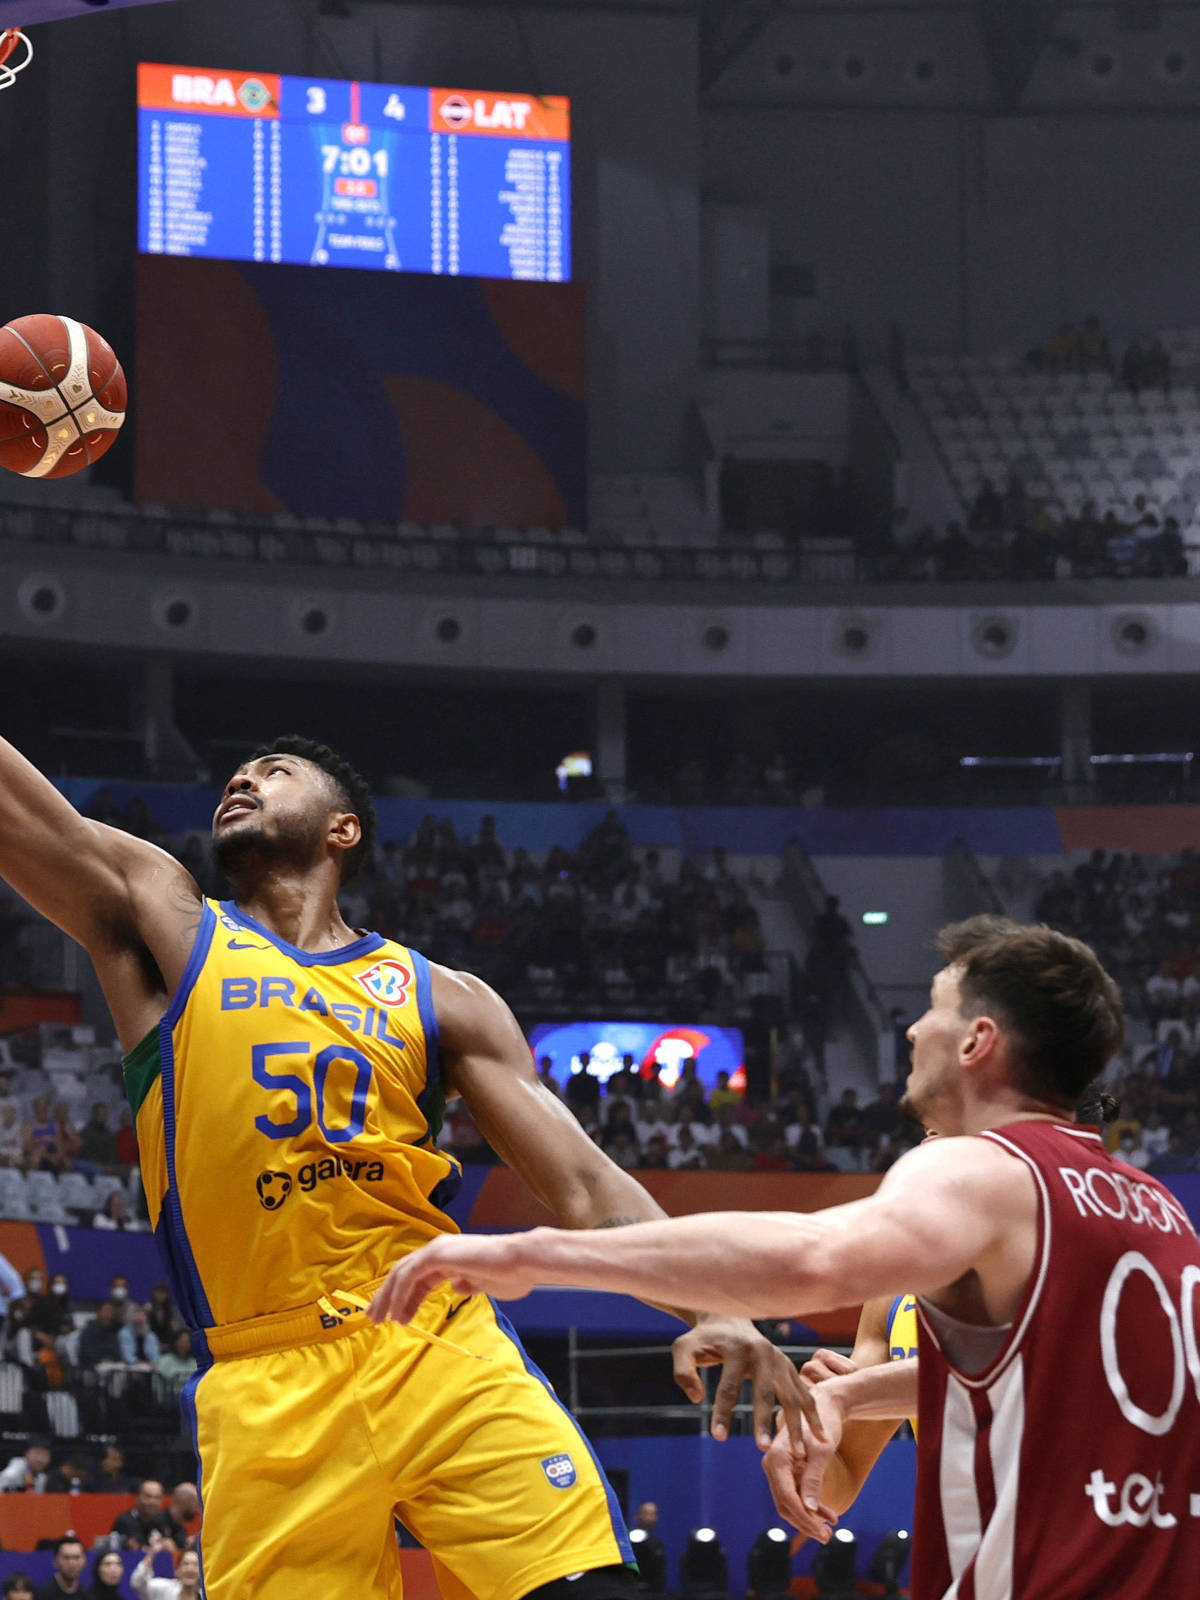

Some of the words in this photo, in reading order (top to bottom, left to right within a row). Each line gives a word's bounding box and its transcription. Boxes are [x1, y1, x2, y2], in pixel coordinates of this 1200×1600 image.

[171, 74, 237, 106] BRA
[306, 86, 326, 114] 3
[383, 93, 405, 121] 4
[474, 99, 531, 129] LAT
[321, 144, 388, 177] 7:01
[221, 977, 406, 1050] BRASIL
[252, 1041, 373, 1142] 50
[297, 1154, 384, 1192] galera
